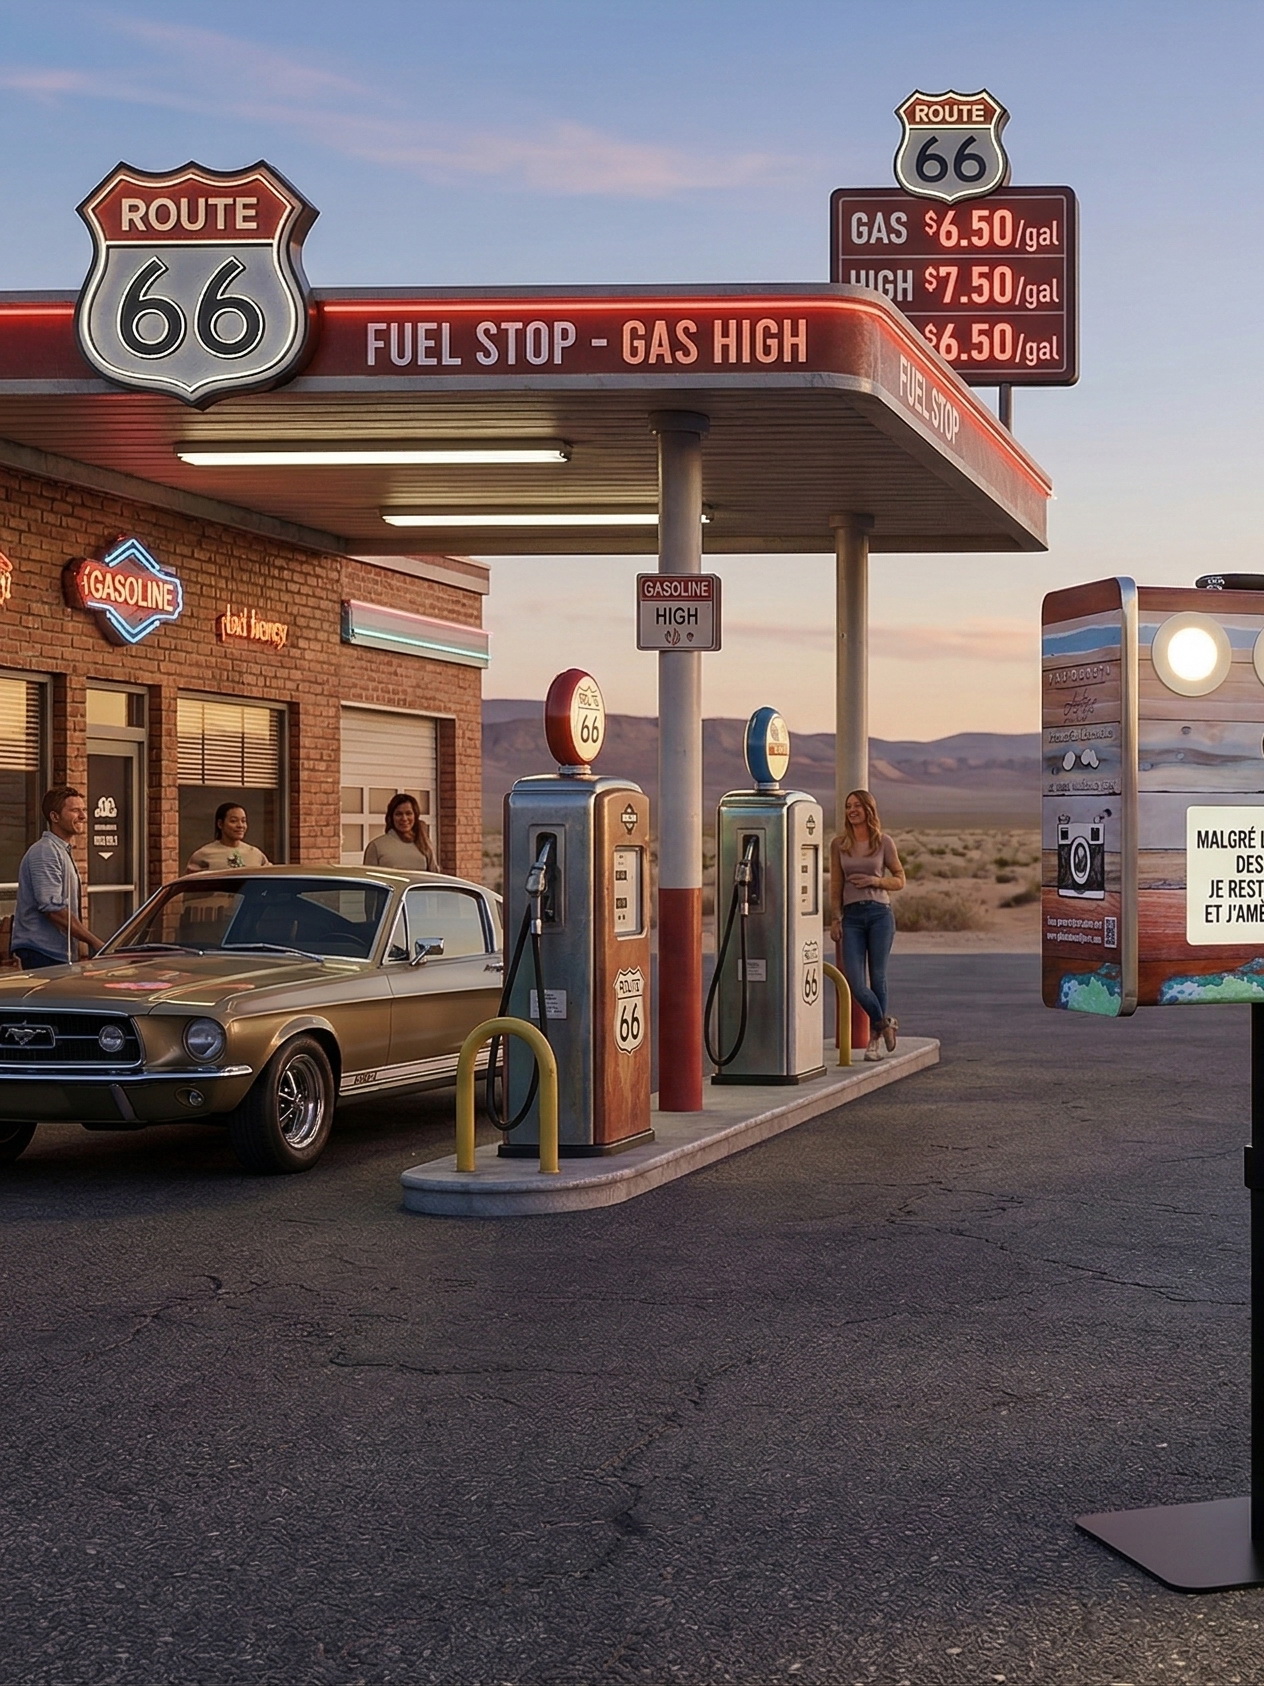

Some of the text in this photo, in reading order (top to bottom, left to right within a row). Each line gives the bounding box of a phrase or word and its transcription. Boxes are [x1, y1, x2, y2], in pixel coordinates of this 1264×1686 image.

[915, 104, 985, 123] ROUTE
[915, 135, 987, 183] 66
[120, 197, 258, 231] ROUTE
[851, 211, 908, 245] GAS
[116, 255, 264, 360] 66
[366, 321, 462, 367] FUEL
[475, 320, 578, 366] STOP
[622, 319, 699, 365] GAS
[713, 318, 809, 364] HIGH
[900, 353, 960, 445] FUEL STOP
[90, 569, 174, 612] GASOLINE
[644, 581, 709, 597] GASOLINE
[656, 607, 698, 626] HIGH
[580, 714, 600, 744] 66
[1197, 826, 1256, 849] MALGRÉ
[1236, 855, 1264, 873] DES
[1208, 879, 1224, 899] JE
[1204, 904, 1223, 923] ET
[805, 968, 818, 998] 66
[620, 1003, 640, 1042] 66
